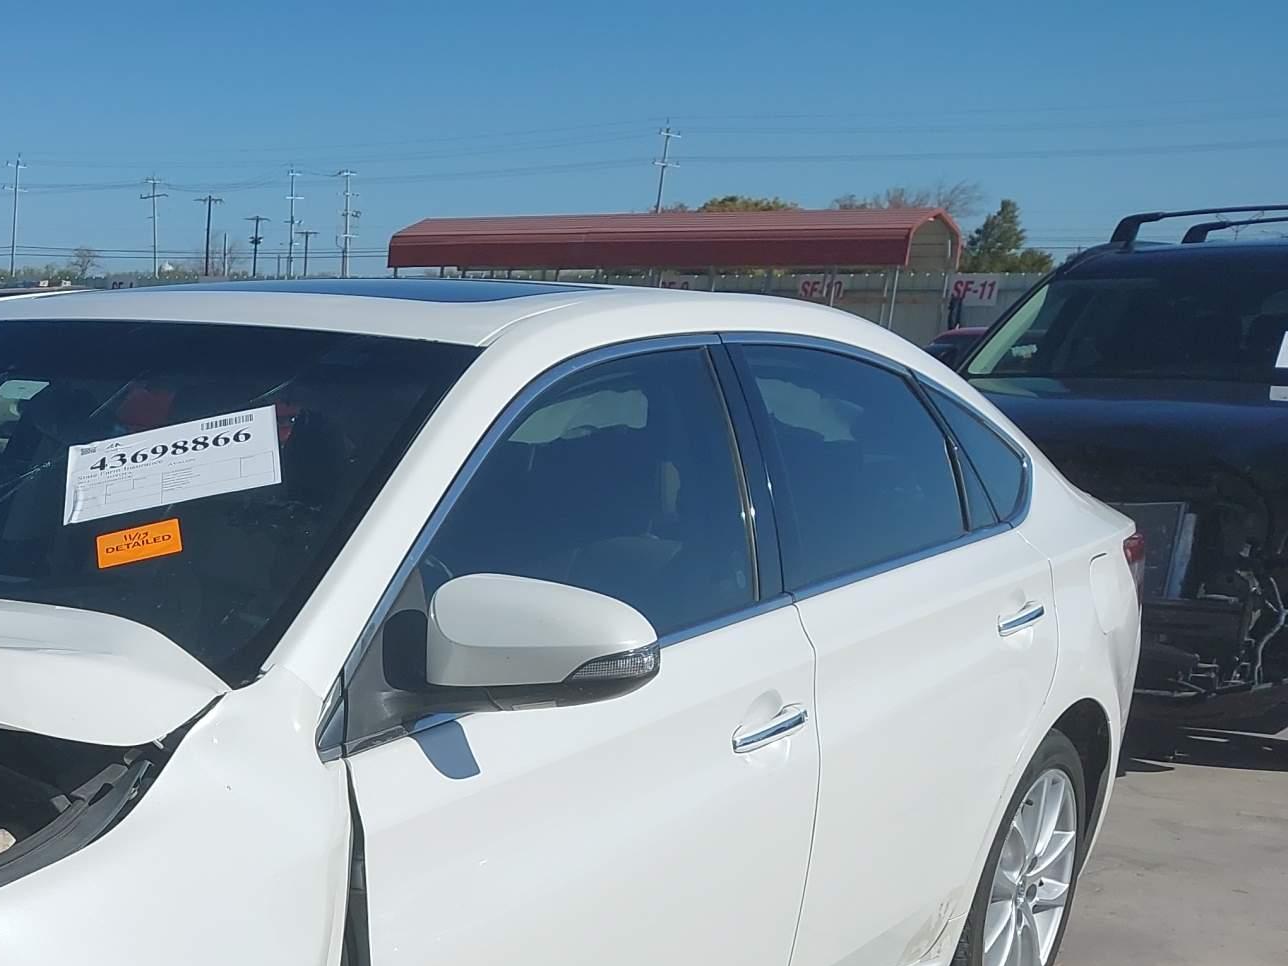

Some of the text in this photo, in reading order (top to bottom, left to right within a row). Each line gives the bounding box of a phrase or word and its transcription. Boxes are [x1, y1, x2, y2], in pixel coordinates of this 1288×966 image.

[952, 279, 997, 300] SF-11
[90, 426, 252, 471] 43698866
[105, 534, 172, 554] DETAILED
